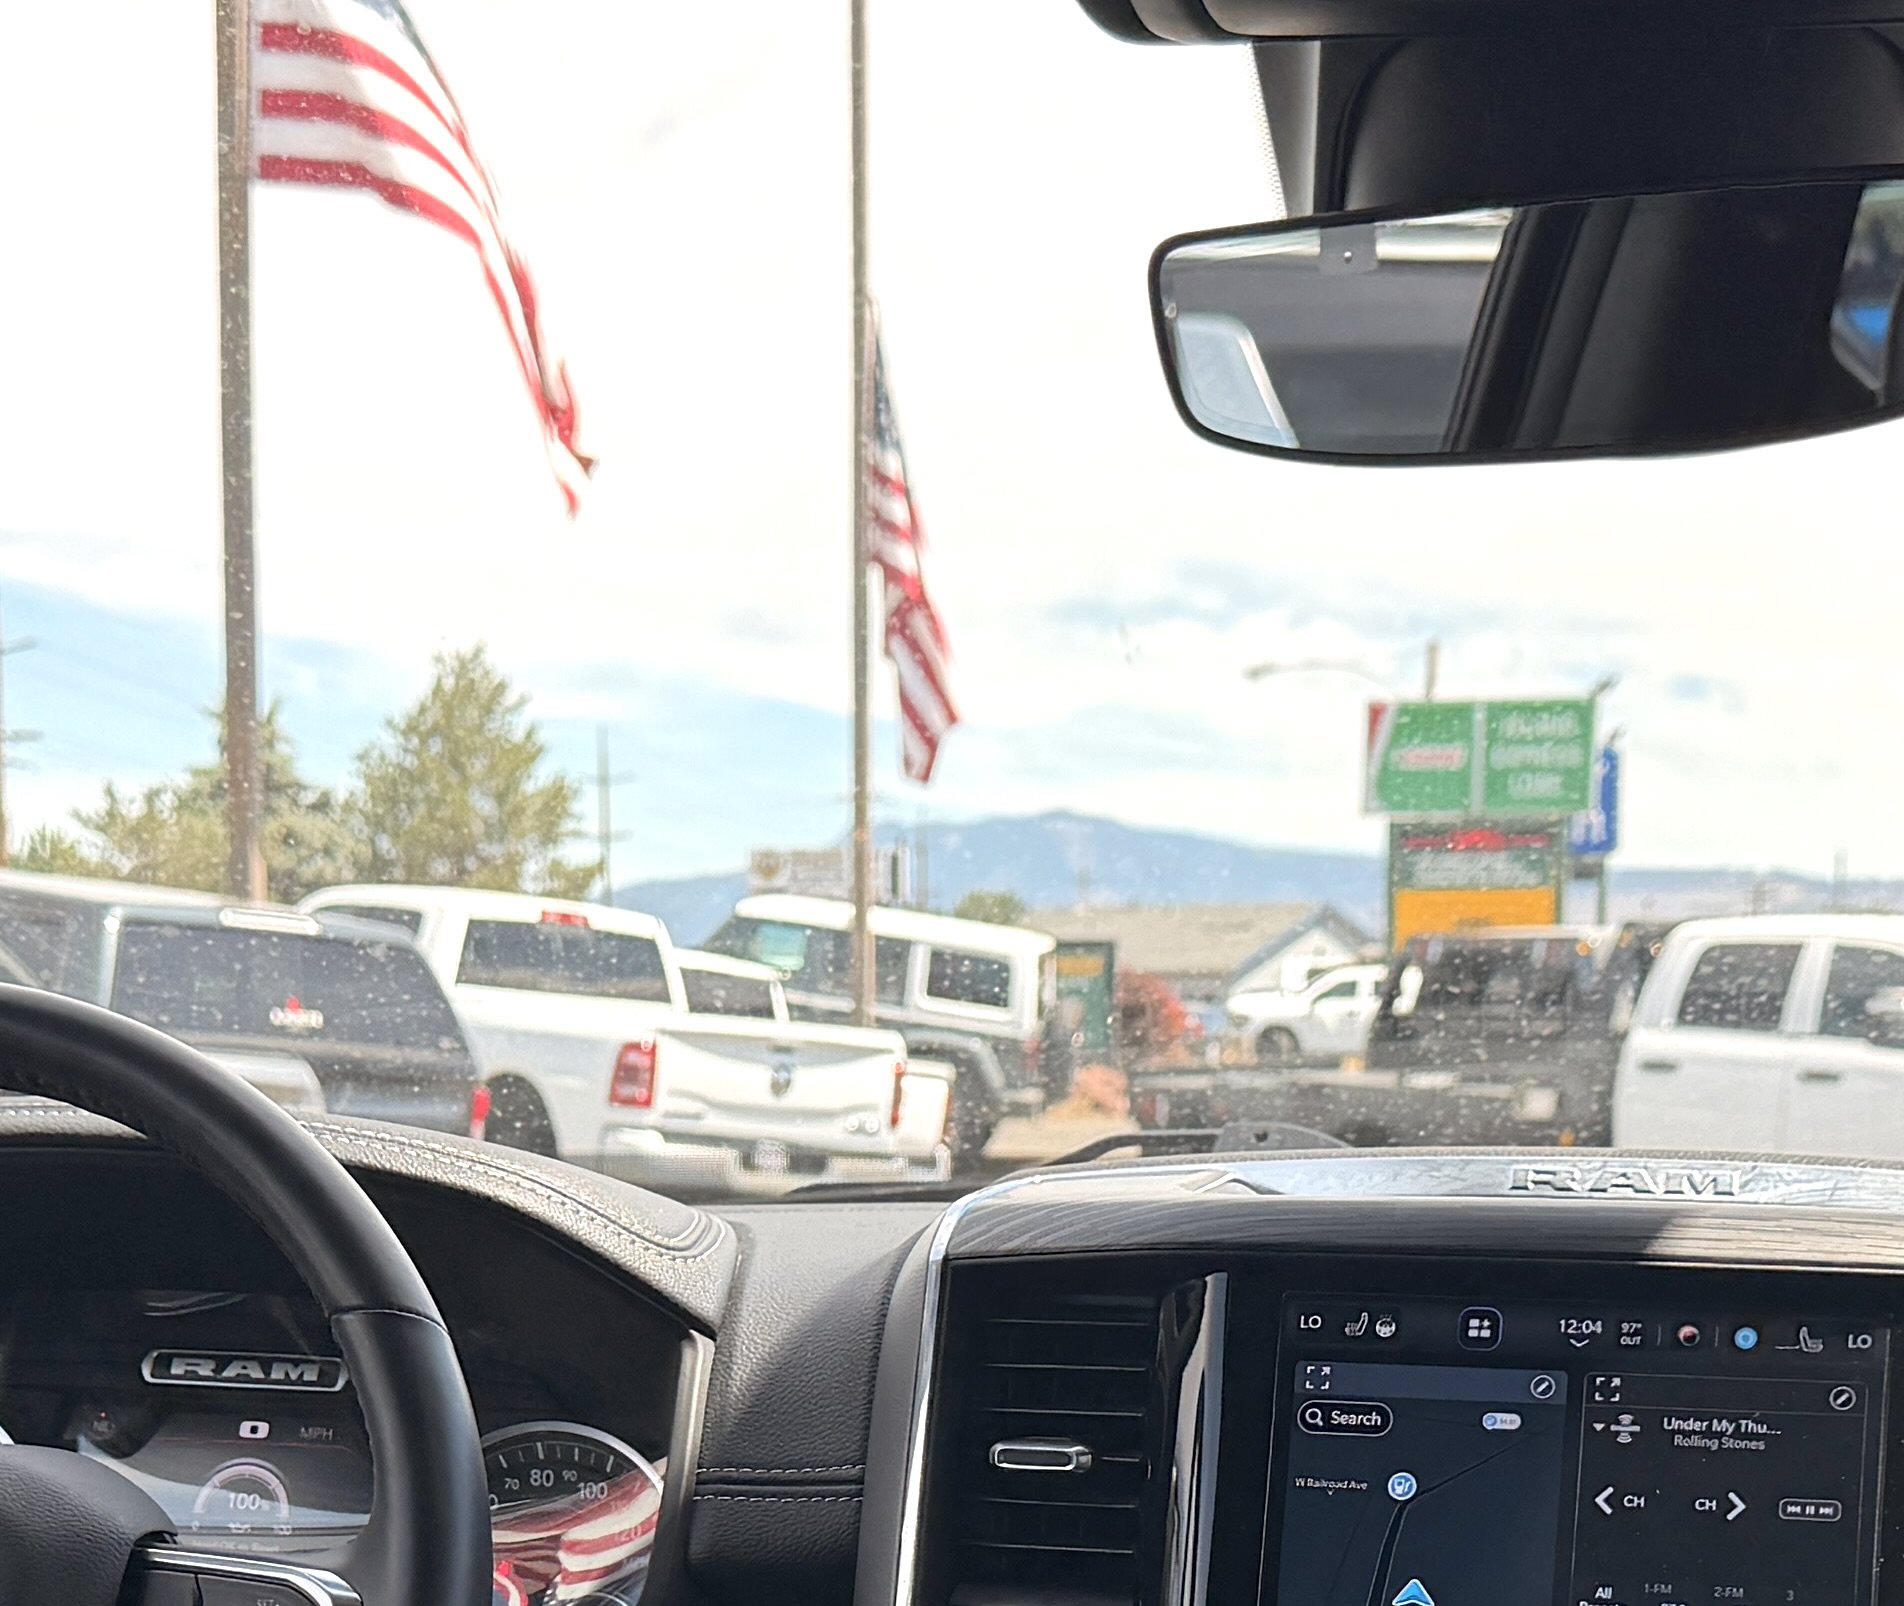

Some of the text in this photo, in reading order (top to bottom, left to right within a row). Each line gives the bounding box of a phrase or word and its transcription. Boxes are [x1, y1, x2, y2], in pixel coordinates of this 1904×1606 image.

[1509, 1167, 1740, 1196] RAM
[1300, 1315, 1322, 1330] LO
[1559, 1319, 1603, 1335] 12:04
[1620, 1336, 1642, 1346] OUT
[1847, 1333, 1873, 1349] LO
[170, 1357, 321, 1382] RAM
[1330, 1410, 1382, 1427] Search
[239, 1420, 270, 1440] 0
[300, 1426, 334, 1440] MPH
[1663, 1417, 1782, 1436] Under My Thu...
[1674, 1435, 1766, 1451] Rolling Stones
[530, 1468, 555, 1488] 80
[562, 1469, 578, 1482] 90
[504, 1477, 520, 1491] 70
[576, 1482, 608, 1500] 100
[1623, 1495, 1645, 1508] CH
[1695, 1499, 1717, 1512] CH
[1594, 1586, 1612, 1600] All
[1644, 1583, 1673, 1595] 1-FM
[1713, 1586, 1744, 1599] 2-FM
